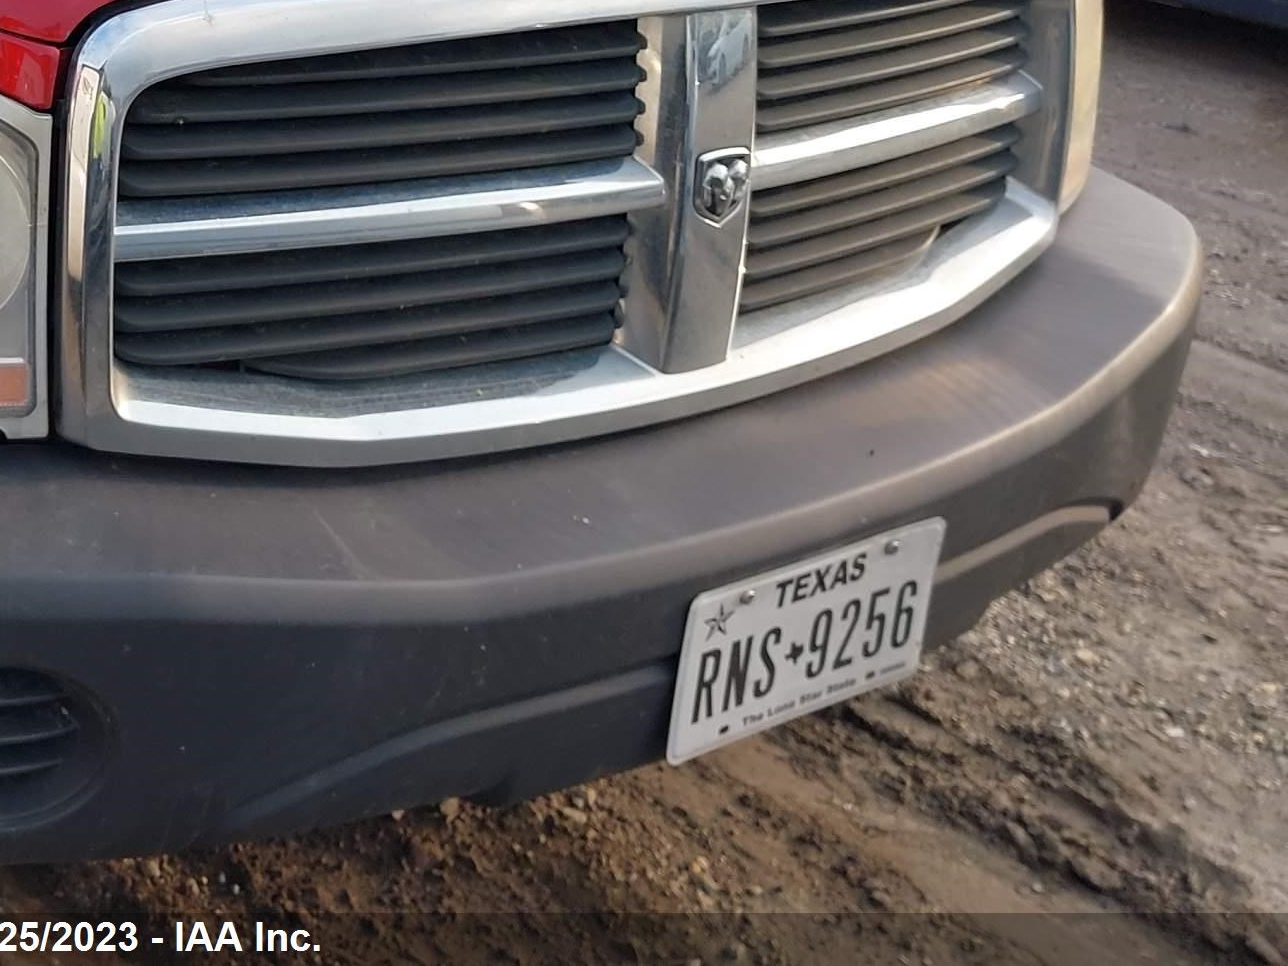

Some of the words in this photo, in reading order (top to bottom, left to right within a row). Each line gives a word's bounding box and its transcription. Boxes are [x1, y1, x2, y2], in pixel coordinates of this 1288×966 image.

[776, 553, 867, 608] TEXAS
[691, 626, 781, 724] RNS
[806, 580, 918, 679] 9256
